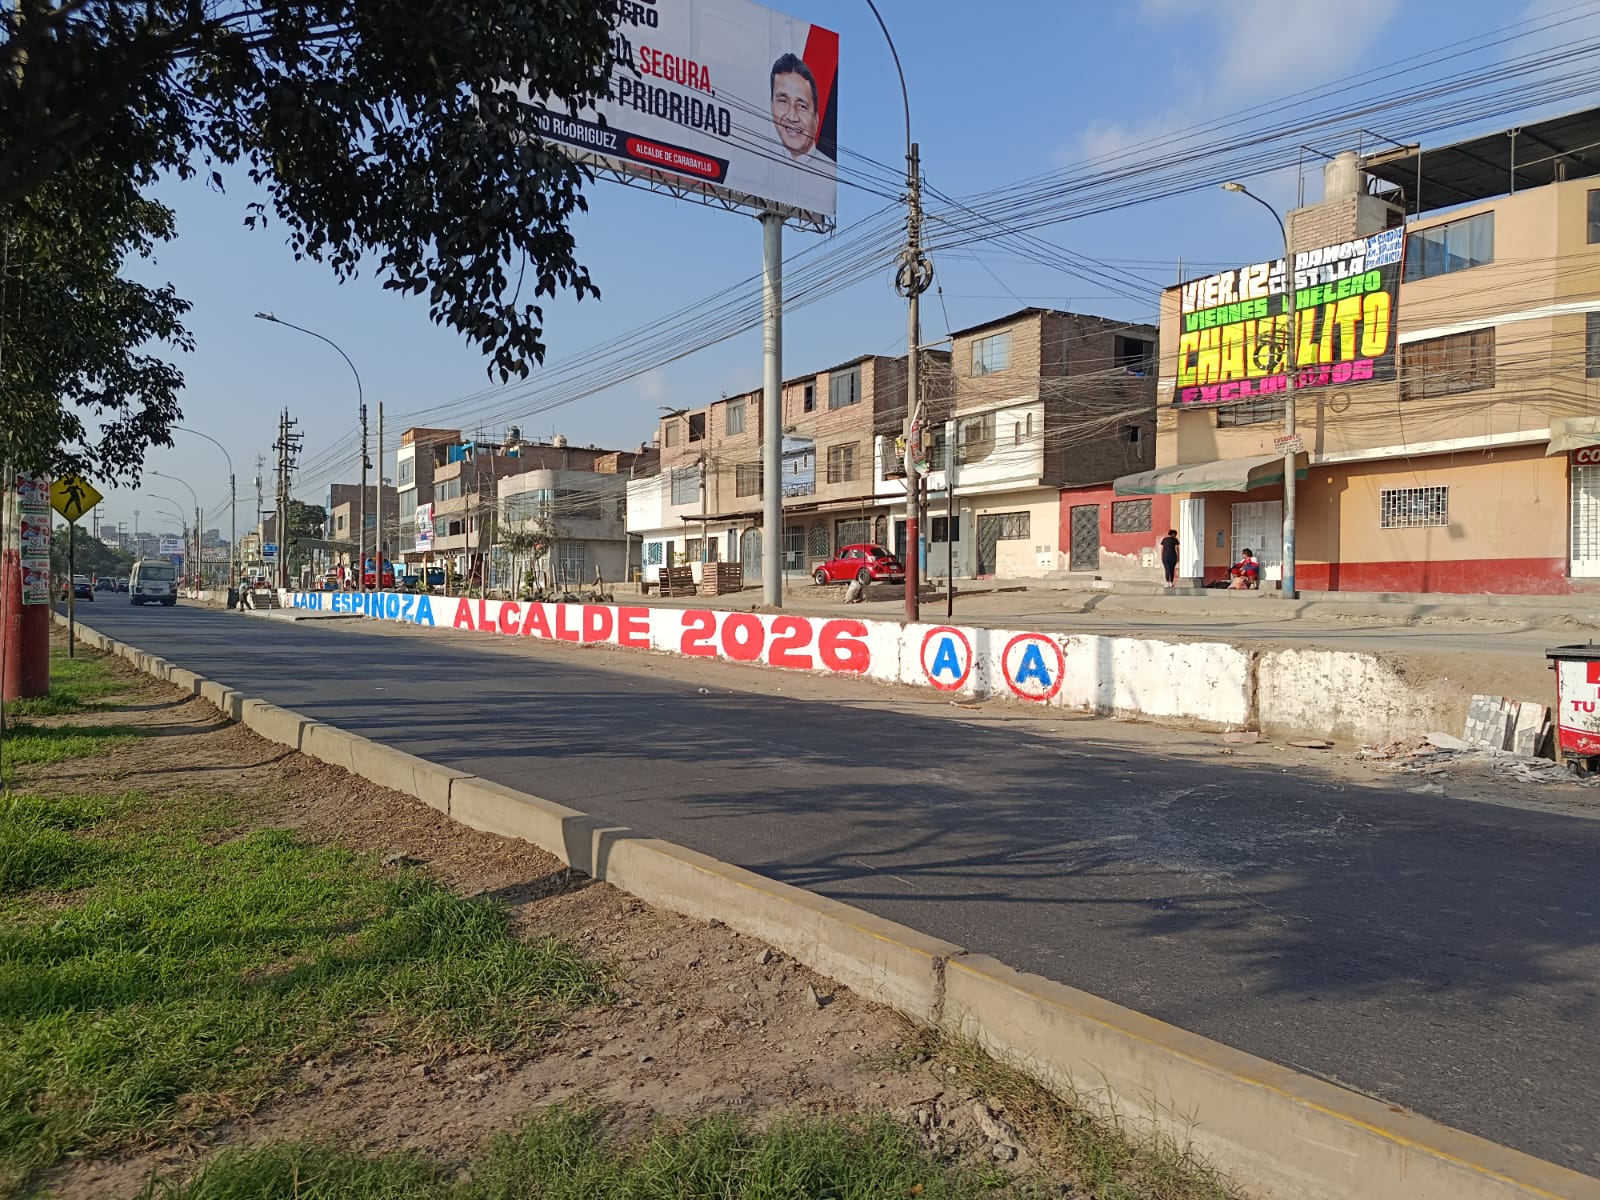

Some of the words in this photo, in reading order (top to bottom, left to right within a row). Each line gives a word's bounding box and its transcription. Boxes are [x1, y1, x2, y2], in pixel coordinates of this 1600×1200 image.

[640, 45, 715, 98] SEGURA,
[619, 76, 731, 138] PRIORIDAD
[553, 118, 617, 150] RODRIGUEZ
[636, 144, 663, 160] ALCALDE
[665, 152, 673, 162] DE
[674, 154, 712, 173] CARABAYLLO
[1295, 238, 1366, 271] RAMON
[1239, 262, 1269, 303] 12
[1186, 297, 1268, 332] VIERNES
[294, 591, 322, 610] LADI
[332, 592, 435, 627] ESPINOZA
[453, 598, 650, 649] ALCALDE
[680, 609, 870, 674] 2026
[931, 637, 962, 679] A
[1015, 643, 1053, 687] A
[1571, 700, 1596, 713] TU
